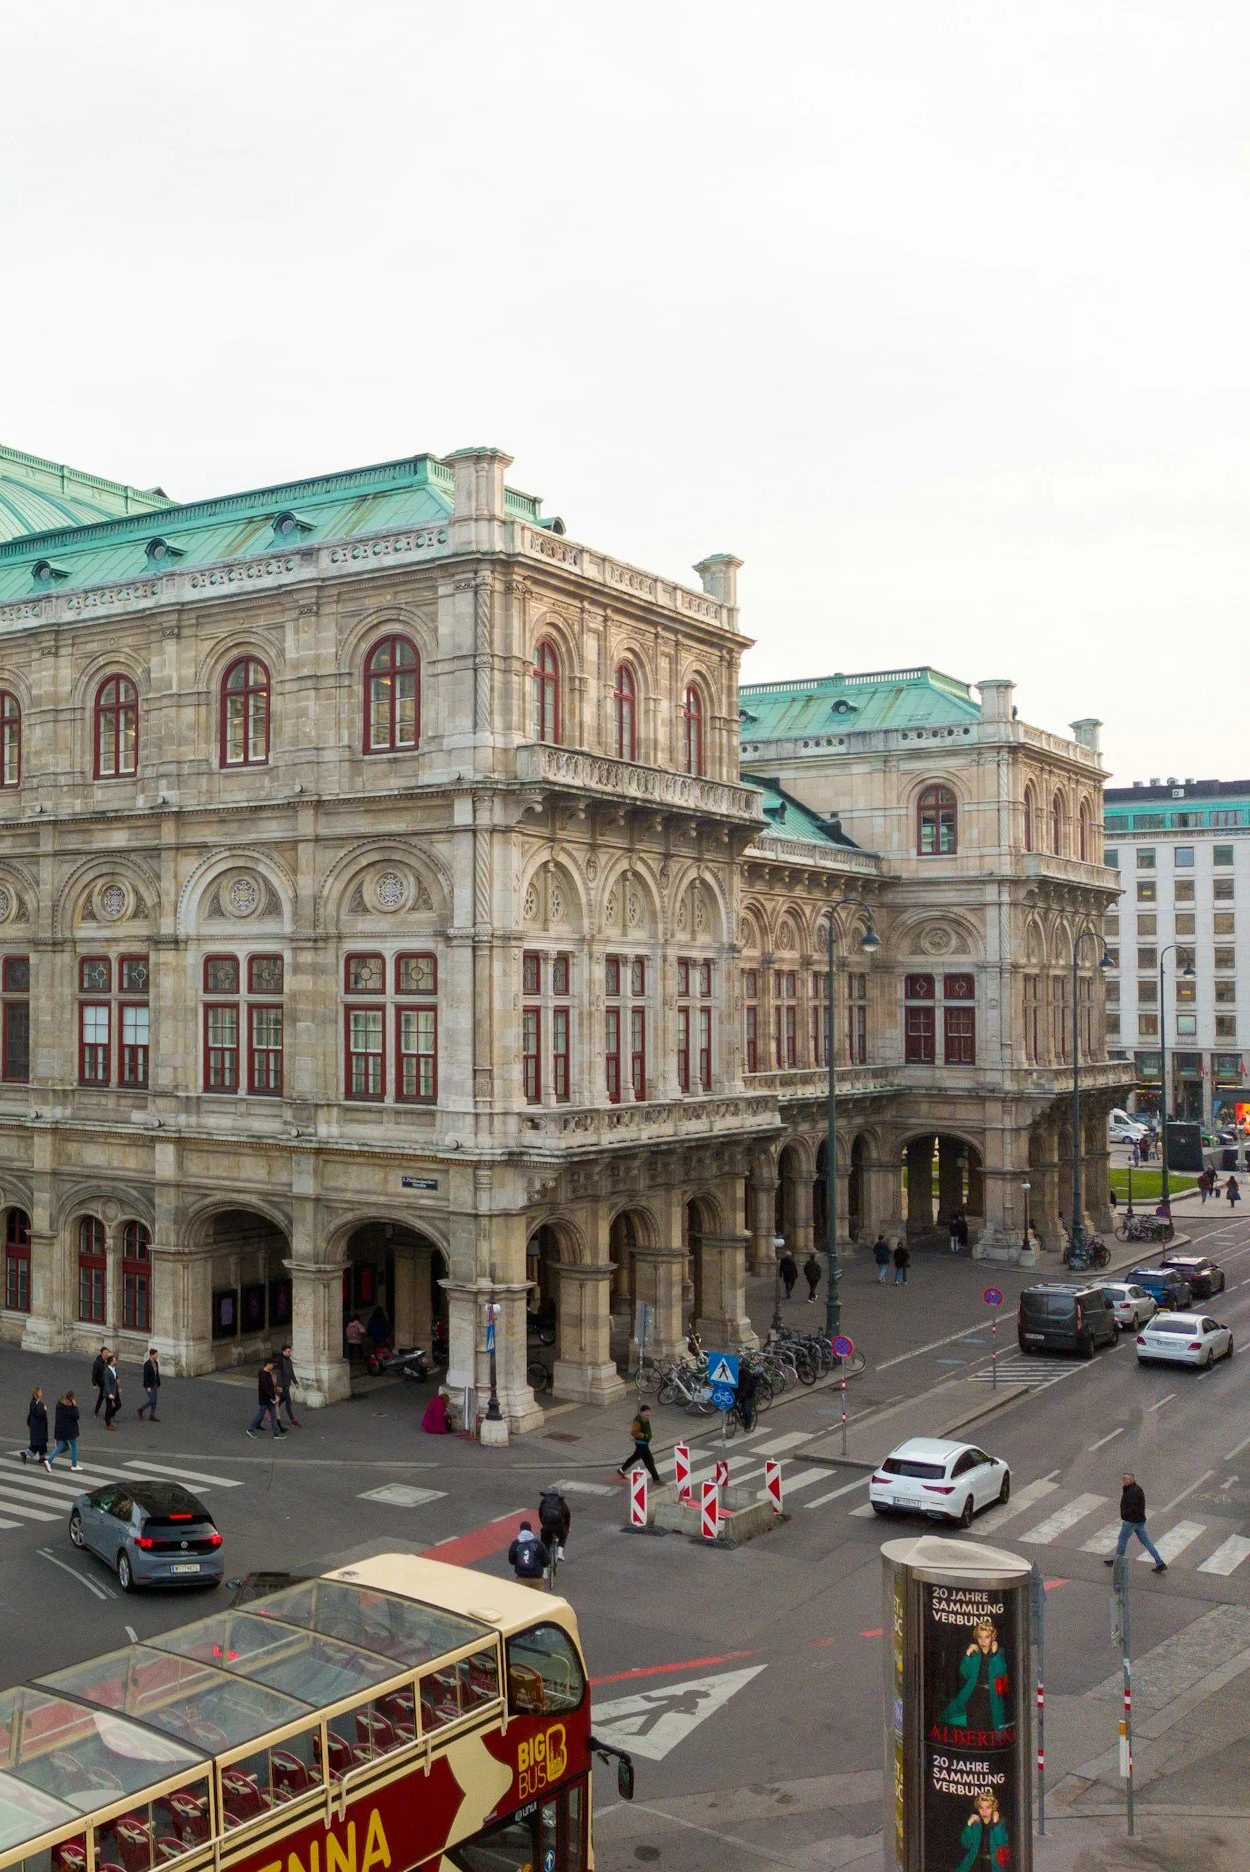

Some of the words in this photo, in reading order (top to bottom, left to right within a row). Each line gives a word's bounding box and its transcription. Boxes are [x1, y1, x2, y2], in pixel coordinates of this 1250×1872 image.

[932, 1586, 948, 1599] 20
[950, 1590, 989, 1603] JAHRE
[932, 1599, 1004, 1615] SAMMLUNG
[932, 1610, 992, 1627] VERBUND
[928, 1724, 1016, 1747] ALBERTIN
[517, 1732, 546, 1773] BIG
[932, 1755, 949, 1768] 20
[951, 1759, 990, 1773] JAHRE
[519, 1762, 547, 1800] BUS
[932, 1767, 1005, 1785] SAMMLUNG
[932, 1779, 993, 1797] VERBUND
[258, 1808, 391, 1872] NNA
